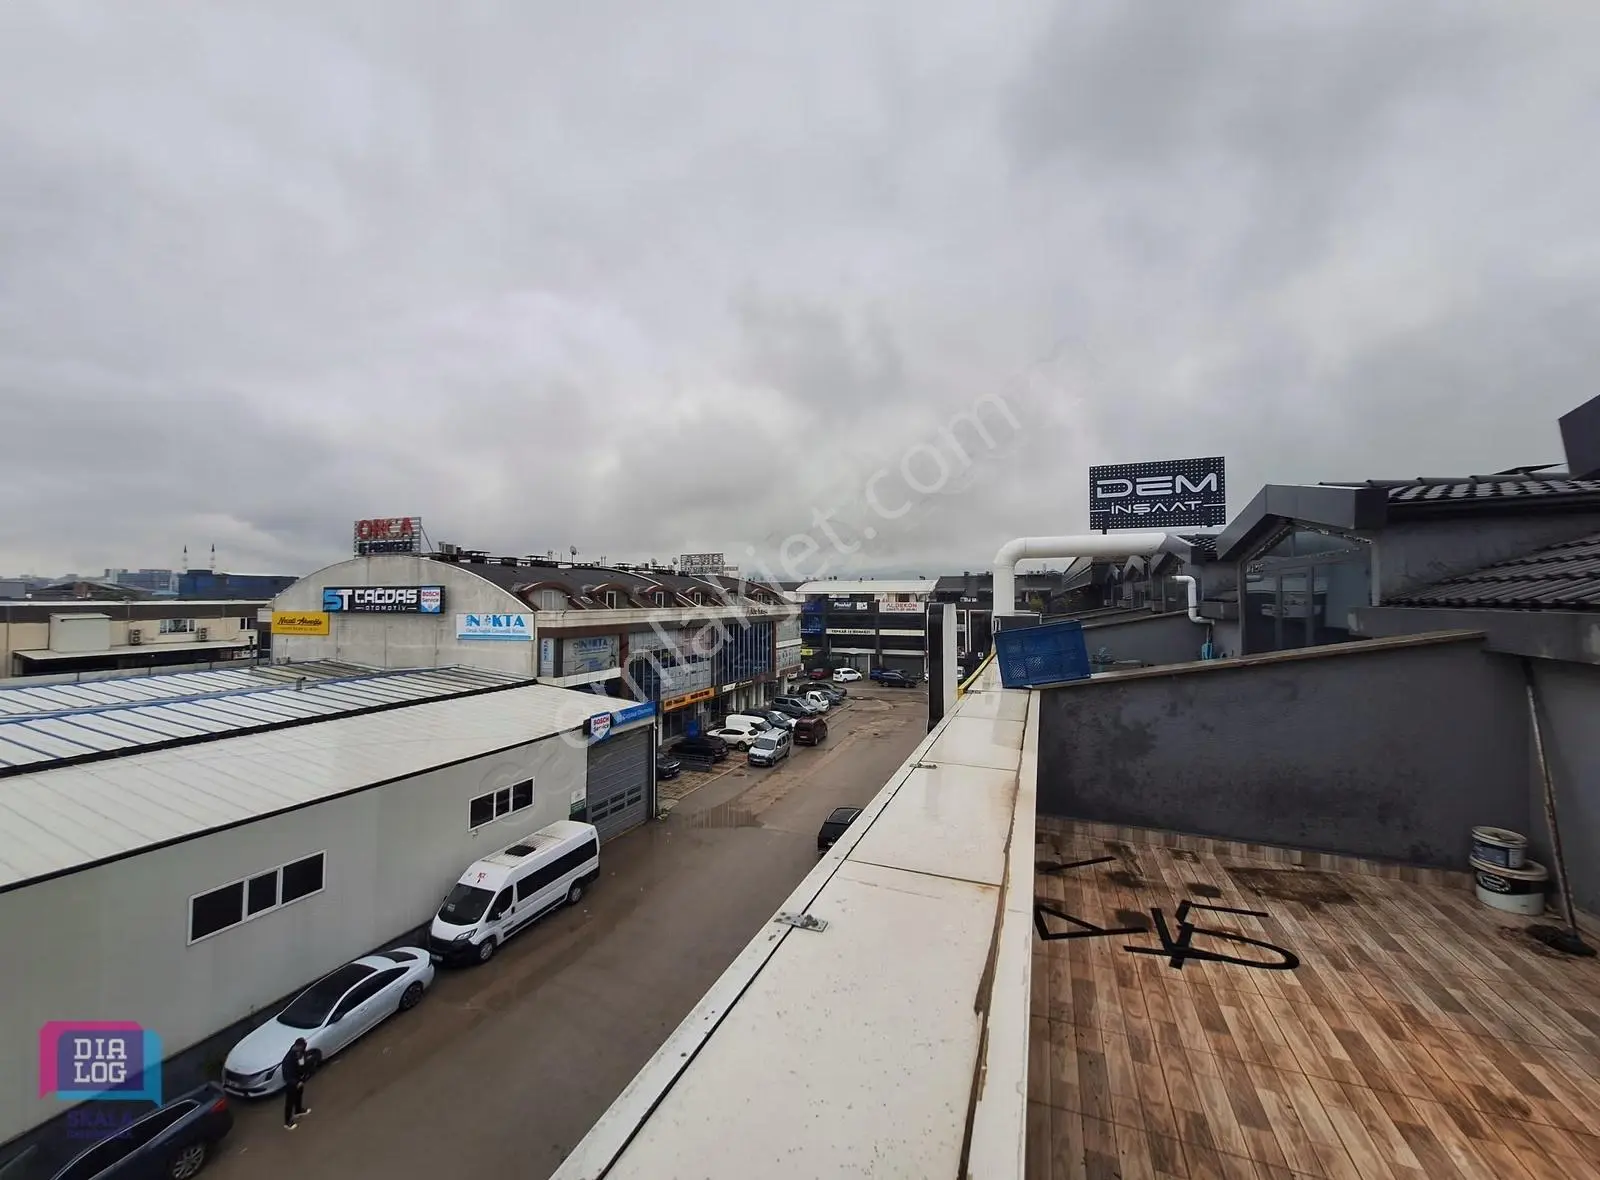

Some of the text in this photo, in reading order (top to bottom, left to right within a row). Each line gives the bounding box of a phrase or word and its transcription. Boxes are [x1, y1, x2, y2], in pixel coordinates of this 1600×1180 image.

[1097, 473, 1217, 498] DEM
[324, 589, 352, 610] ST
[593, 717, 609, 725] BOSCH
